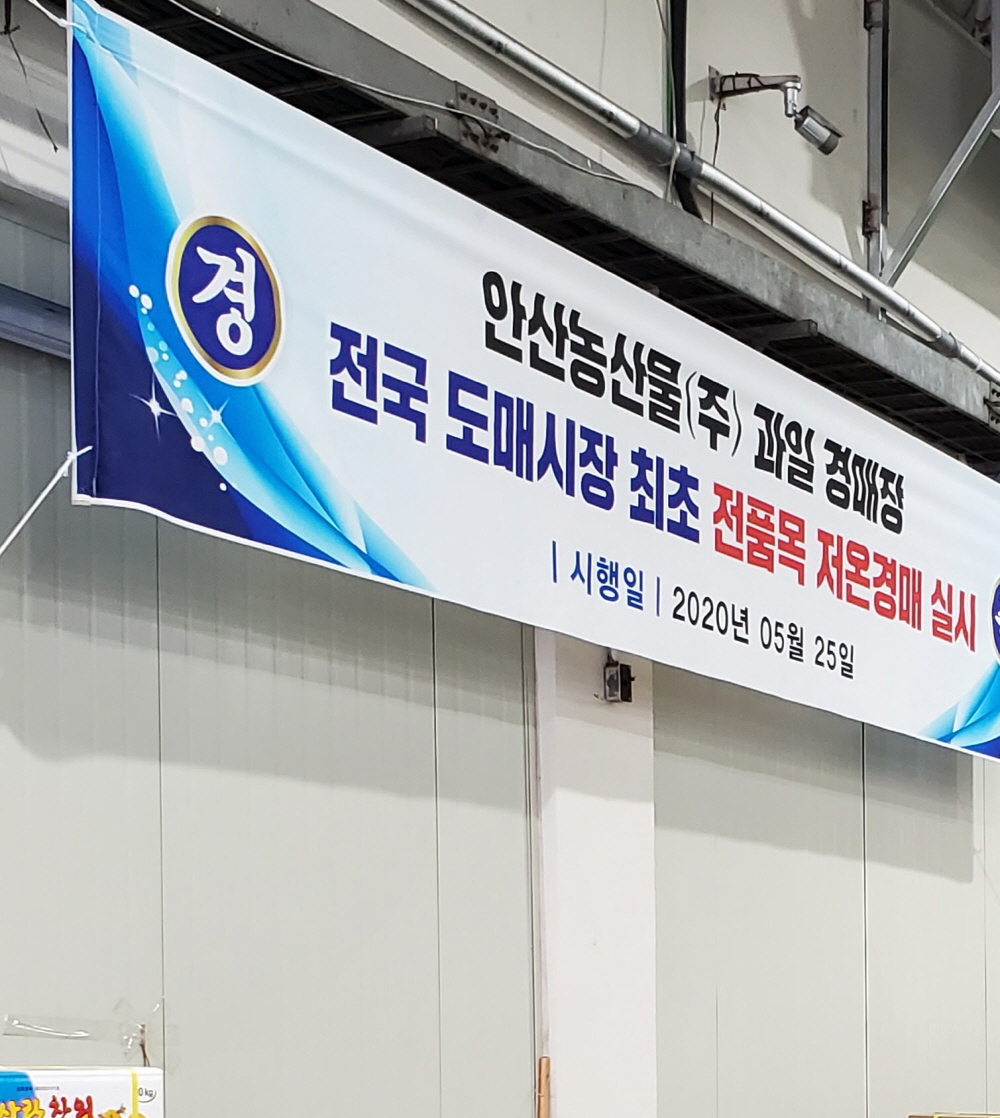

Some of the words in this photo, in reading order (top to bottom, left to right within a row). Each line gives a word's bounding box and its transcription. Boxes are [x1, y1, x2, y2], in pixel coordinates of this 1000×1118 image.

[190, 244, 258, 358] 경
[482, 270, 742, 457] 안산농산물(주)
[753, 402, 816, 494] 과일
[823, 437, 905, 535] 경매장
[329, 321, 429, 444] 전국
[446, 369, 618, 512] 도매시장
[629, 446, 700, 544] 최초
[713, 481, 806, 587] 전품목
[816, 527, 923, 631] 저온경매
[930, 578, 977, 653] 실시
[570, 549, 645, 610] 시행일
[671, 585, 750, 645] 2020년
[759, 615, 805, 664] 05월
[814, 635, 855, 680] 25일
